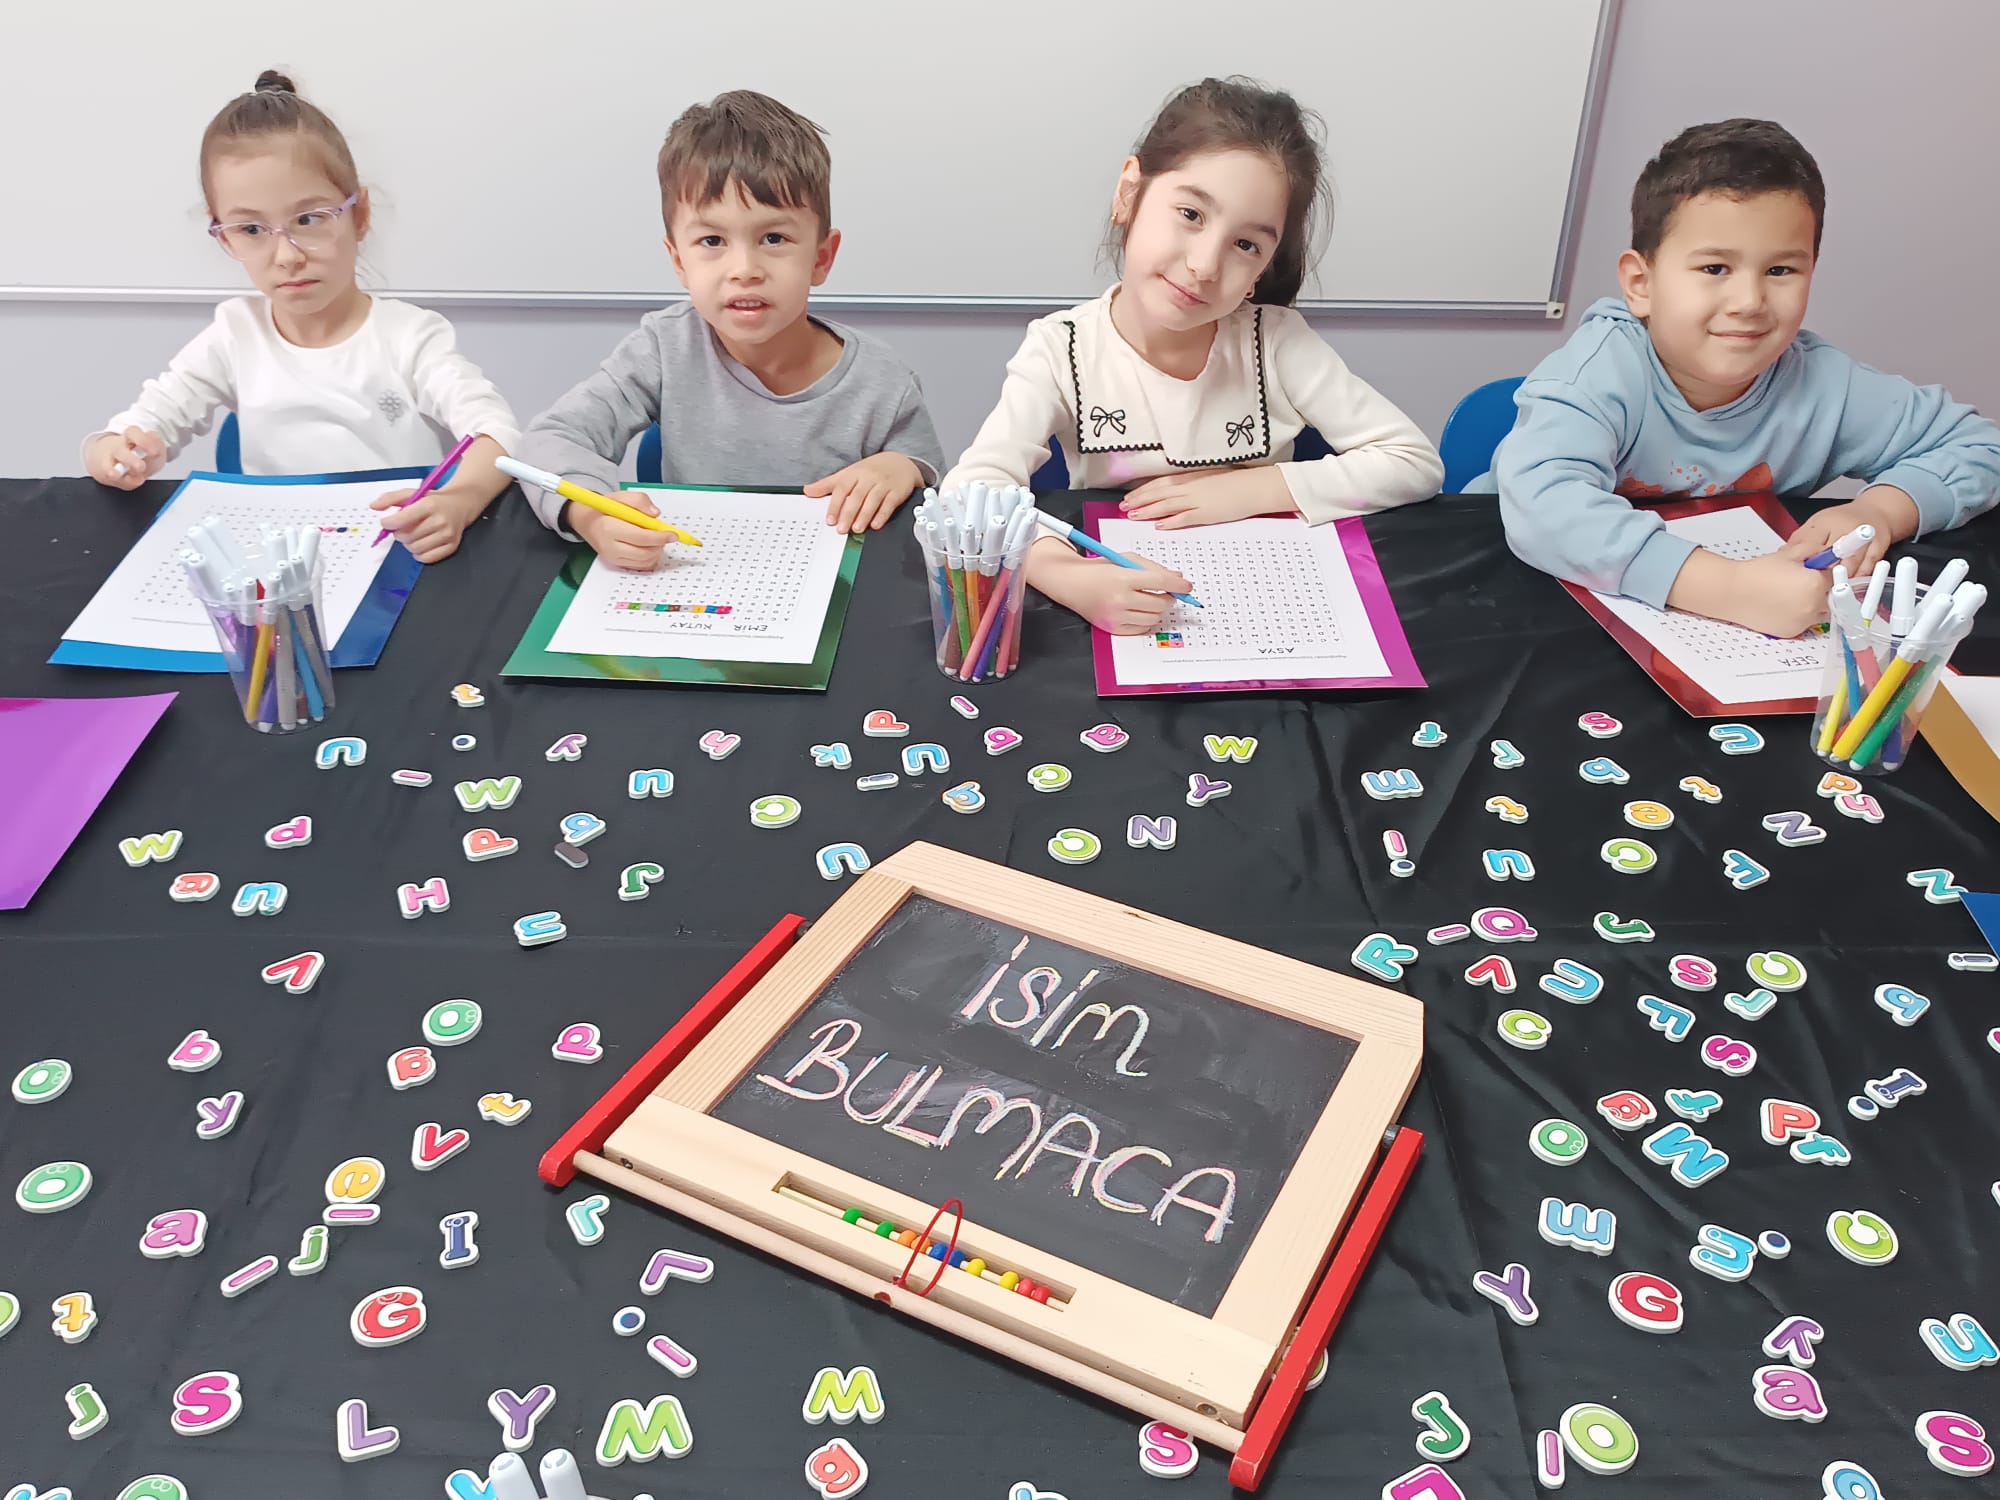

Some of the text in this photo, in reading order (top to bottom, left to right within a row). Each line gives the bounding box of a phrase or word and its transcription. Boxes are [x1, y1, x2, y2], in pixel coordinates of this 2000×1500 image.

[1777, 655, 1819, 667] SEFA
[1129, 817, 1174, 845] N
[399, 880, 448, 914] H
[1473, 909, 1536, 938] Q
[1353, 935, 1416, 977] R
[756, 1018, 1237, 1244] BULMACA
[1763, 1102, 1818, 1140] P
[141, 1211, 206, 1254] a
[290, 1227, 327, 1271] j
[441, 1213, 477, 1264] I
[352, 1288, 425, 1342] G
[1475, 1265, 1537, 1320] Y
[1610, 1274, 1681, 1329] G
[67, 1385, 107, 1435] j
[173, 1373, 240, 1431] S
[490, 1386, 554, 1448] Y
[804, 1368, 883, 1420] M
[1755, 1367, 1826, 1418] a
[339, 1401, 398, 1457] L
[598, 1397, 691, 1462] M
[1141, 1423, 1197, 1475] S
[1414, 1393, 1468, 1457] J
[1917, 1413, 1993, 1472] S
[807, 1440, 866, 1499] g
